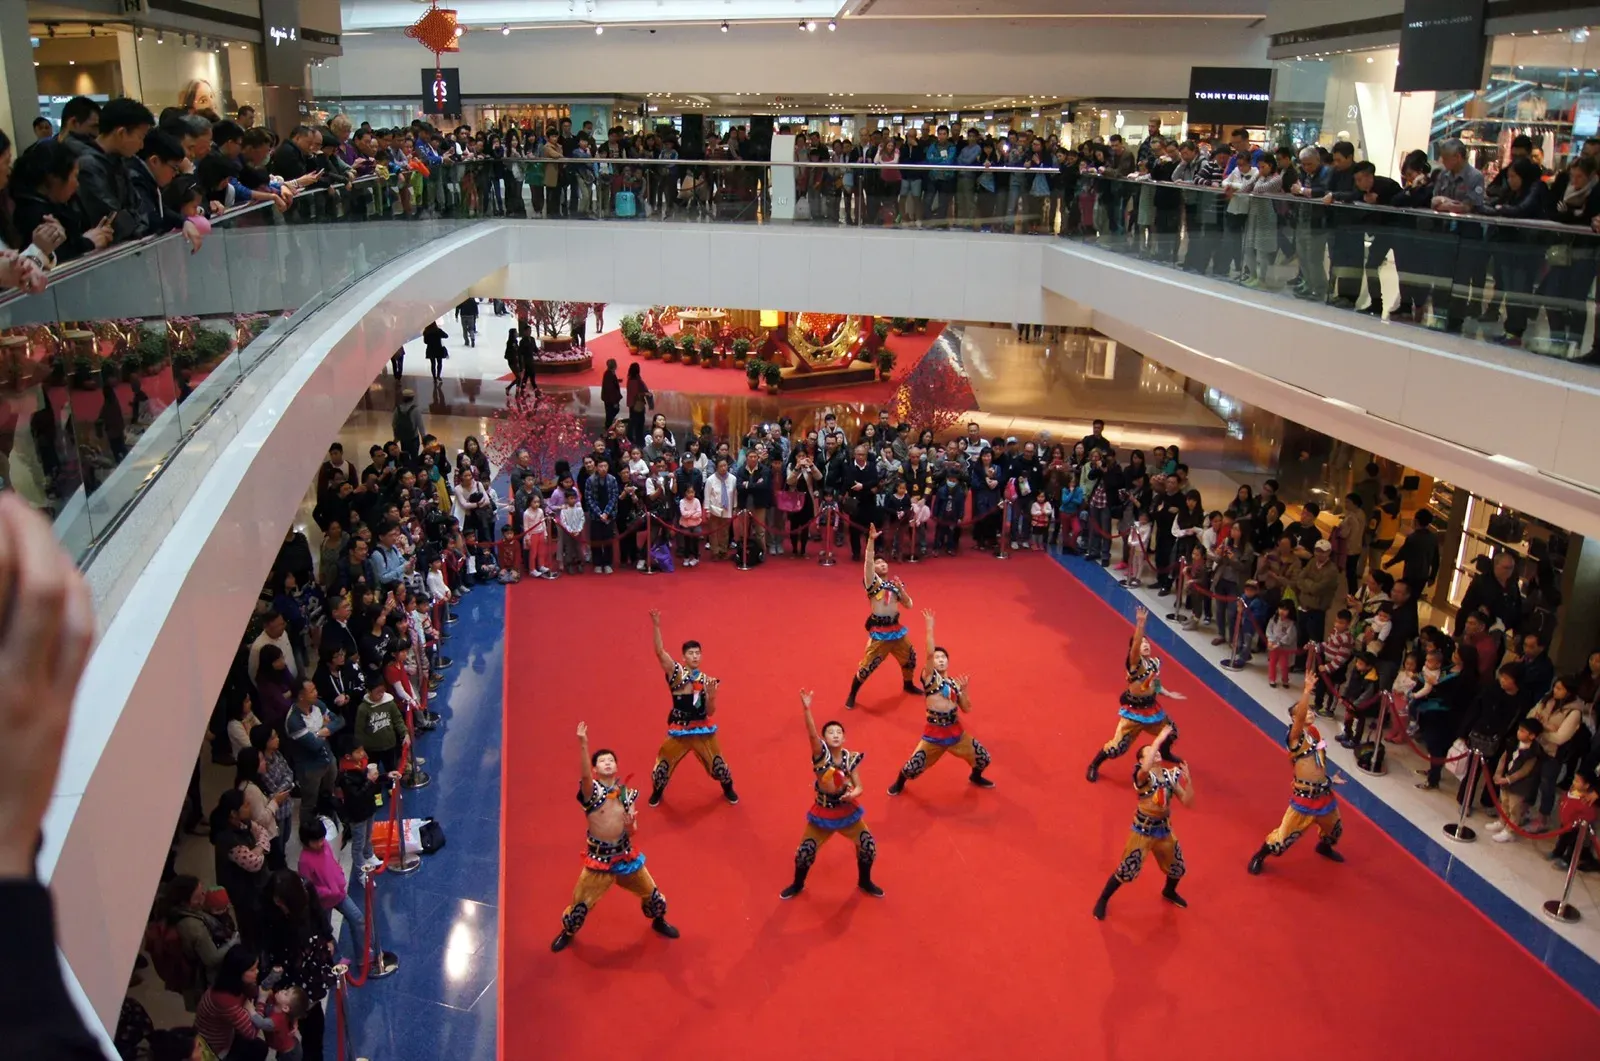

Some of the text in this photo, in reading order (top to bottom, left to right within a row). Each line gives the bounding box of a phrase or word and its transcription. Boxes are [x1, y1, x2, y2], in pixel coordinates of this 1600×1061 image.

[1195, 92, 1270, 101] TOMMY HILFIGER
[876, 493, 886, 507] N
